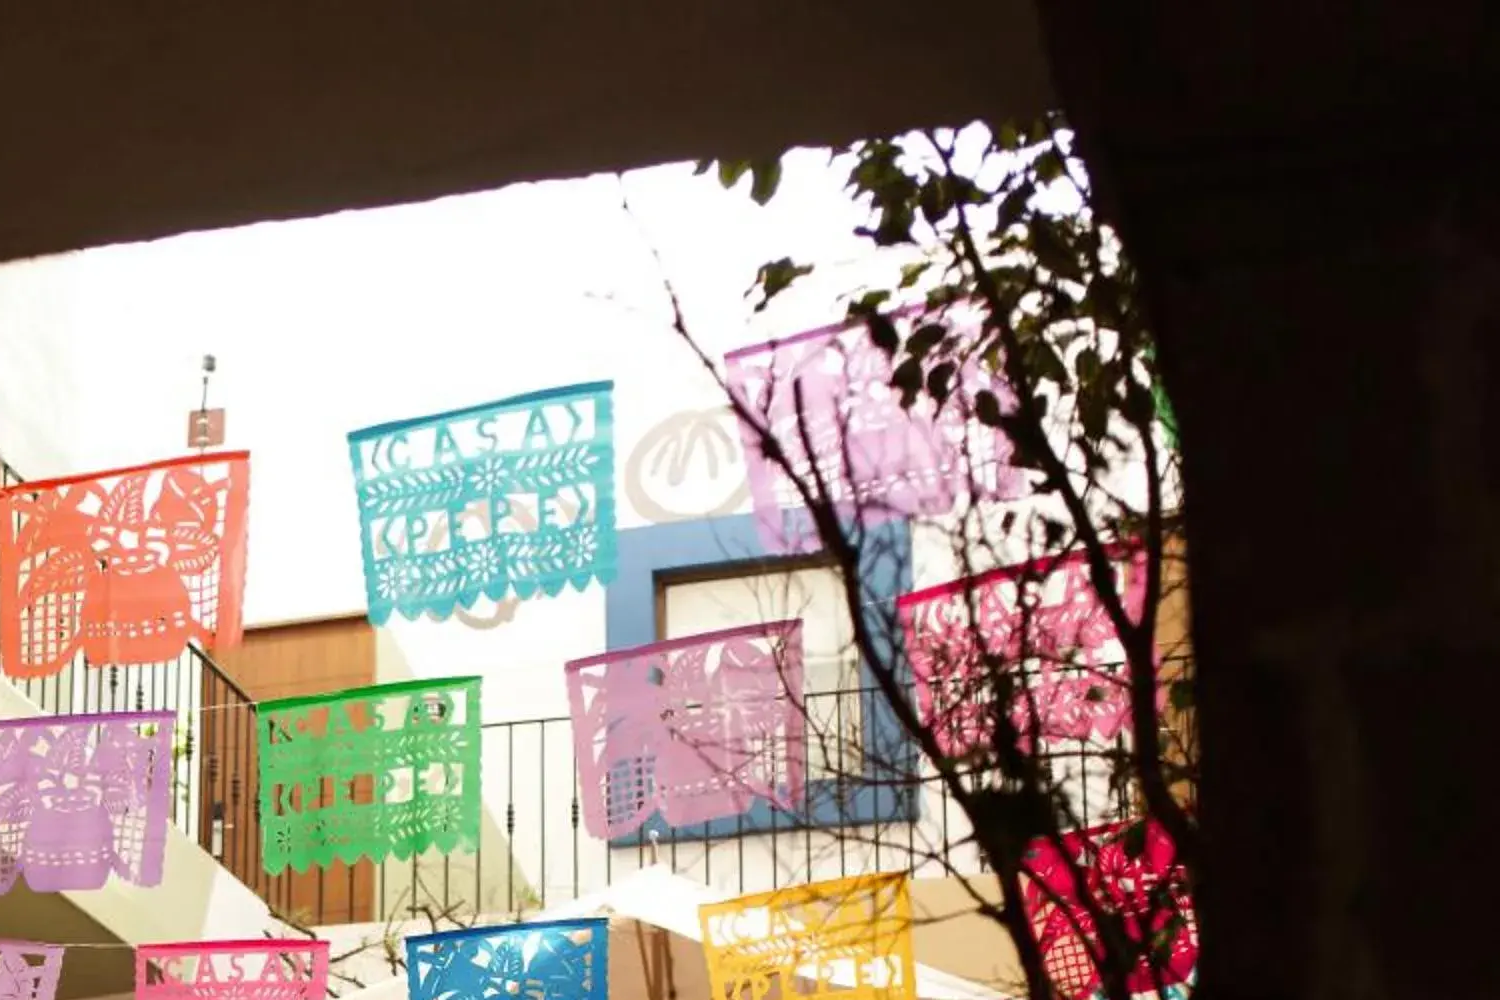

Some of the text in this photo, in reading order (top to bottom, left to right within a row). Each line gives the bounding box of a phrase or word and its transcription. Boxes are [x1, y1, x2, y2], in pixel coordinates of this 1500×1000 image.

[387, 404, 554, 473] CASA
[406, 487, 560, 556] PEPE
[302, 764, 428, 811] PEPE
[164, 952, 281, 985] CASA
